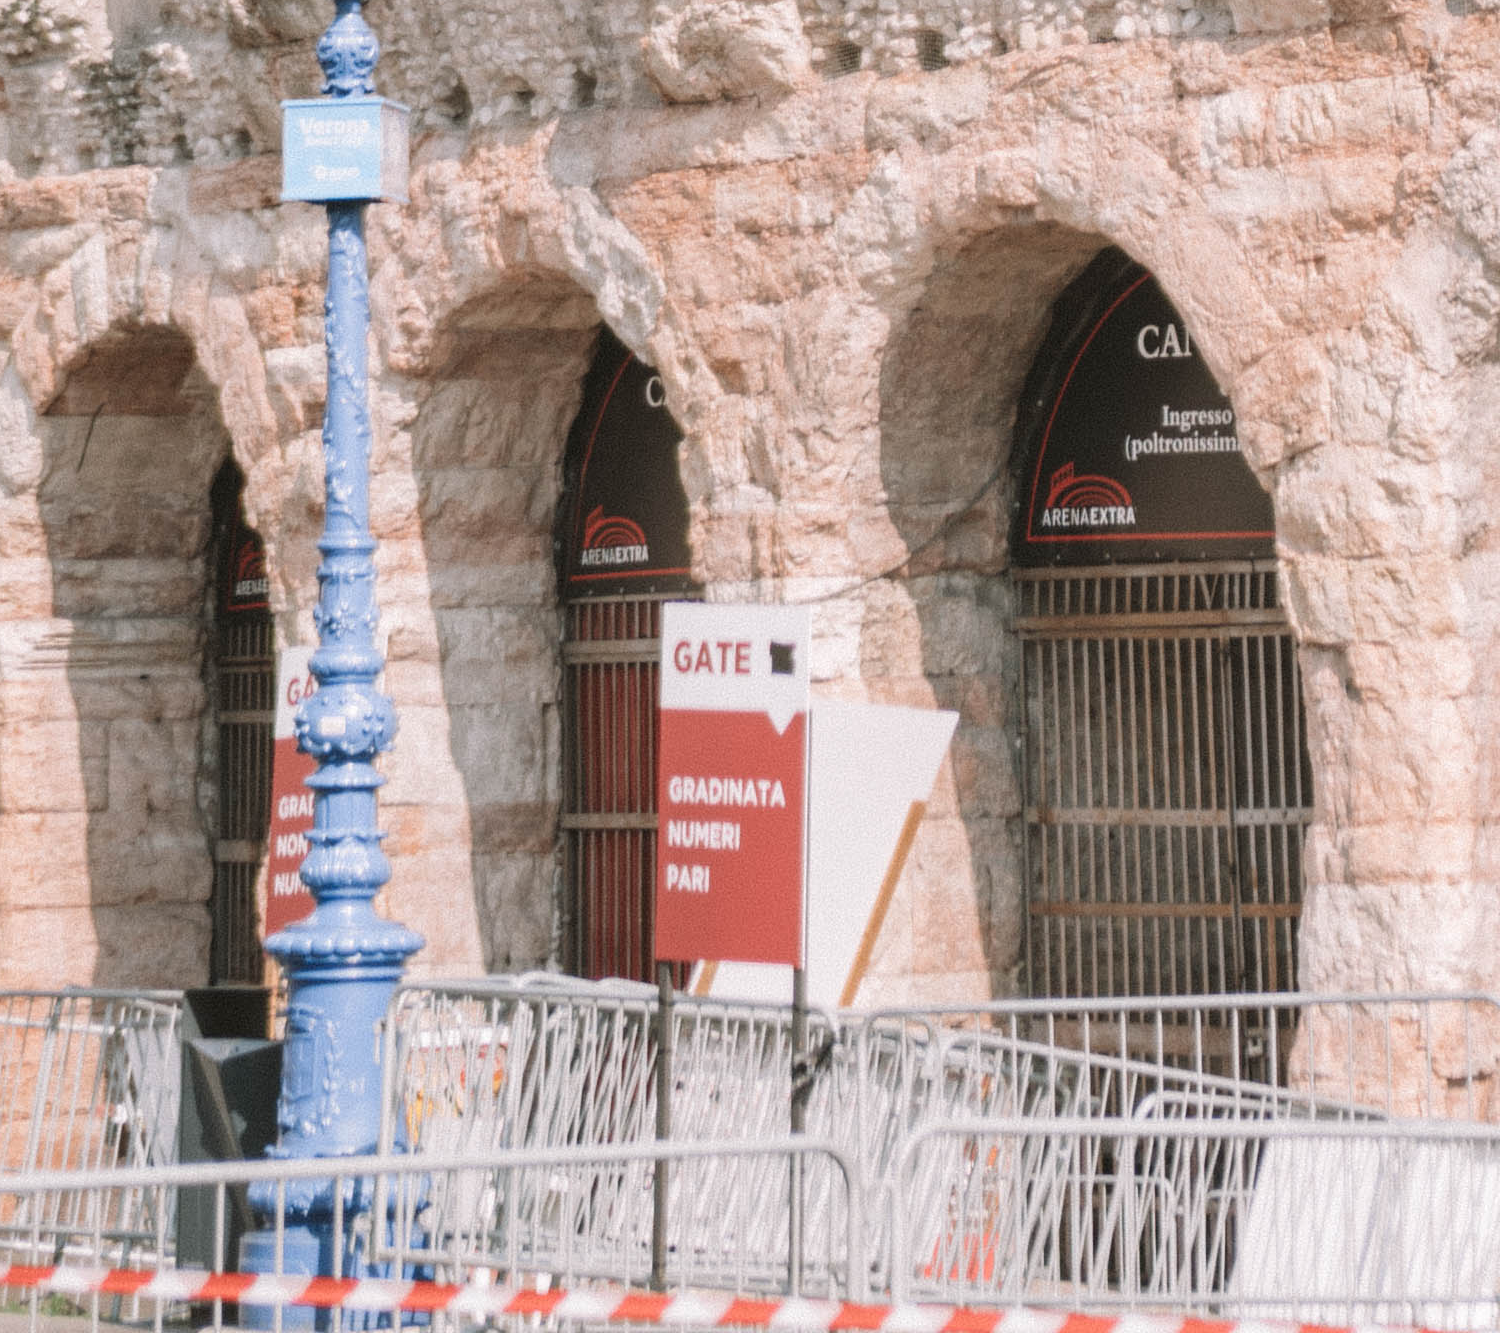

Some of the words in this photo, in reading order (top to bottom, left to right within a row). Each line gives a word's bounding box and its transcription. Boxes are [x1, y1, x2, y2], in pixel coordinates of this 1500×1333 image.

[1162, 404, 1233, 432] Ingresso
[1042, 506, 1136, 527] ARENAEXTRA
[673, 641, 752, 675] GATE
[668, 776, 786, 808] GRADINATA
[667, 821, 740, 851] NUMERI
[666, 864, 710, 893] PARI
